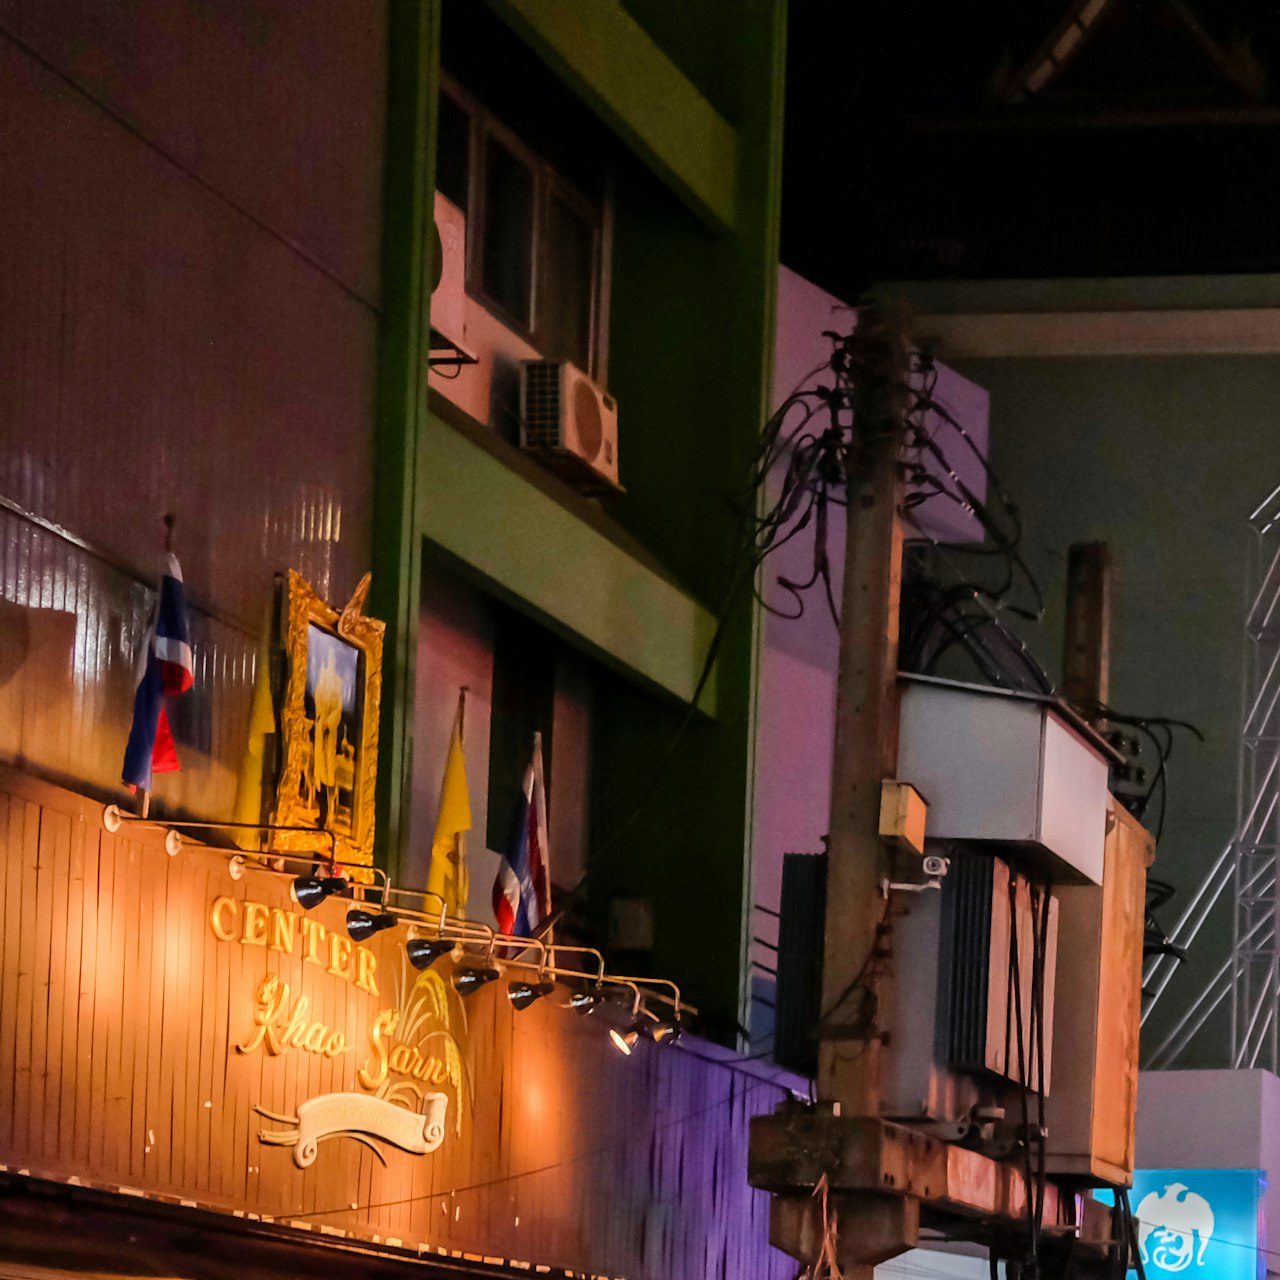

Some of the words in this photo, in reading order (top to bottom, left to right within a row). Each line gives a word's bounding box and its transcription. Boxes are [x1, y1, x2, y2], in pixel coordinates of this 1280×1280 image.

[211, 895, 380, 997] CENTER
[235, 972, 353, 1058] Khao
[358, 1006, 450, 1091] Sarn
